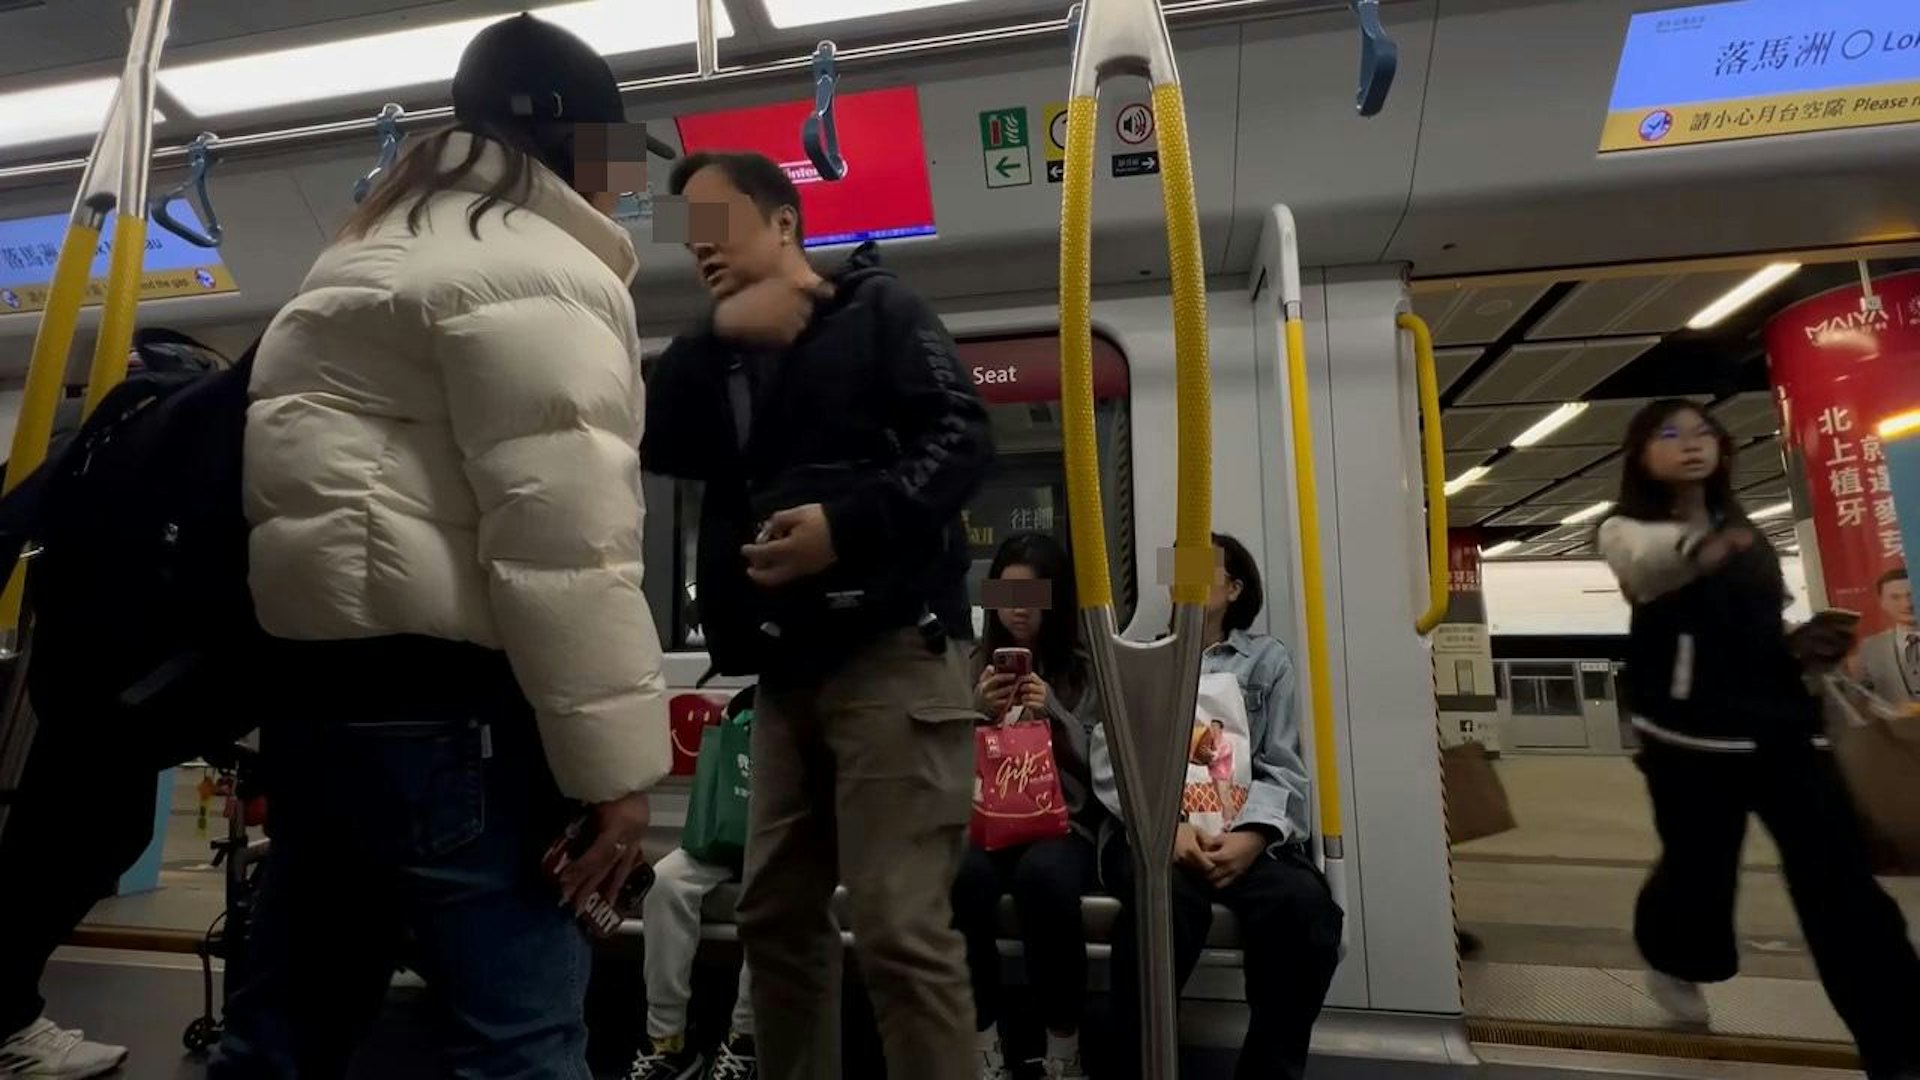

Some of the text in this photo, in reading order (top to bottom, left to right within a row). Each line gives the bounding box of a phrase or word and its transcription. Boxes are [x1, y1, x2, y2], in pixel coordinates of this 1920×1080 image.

[1714, 31, 1835, 77] 落馬洲
[1689, 98, 1847, 132] 請小心月台空隙
[1853, 97, 1908, 112] Please
[972, 365, 1018, 386] Seat
[1817, 406, 1868, 528] 北上植牙
